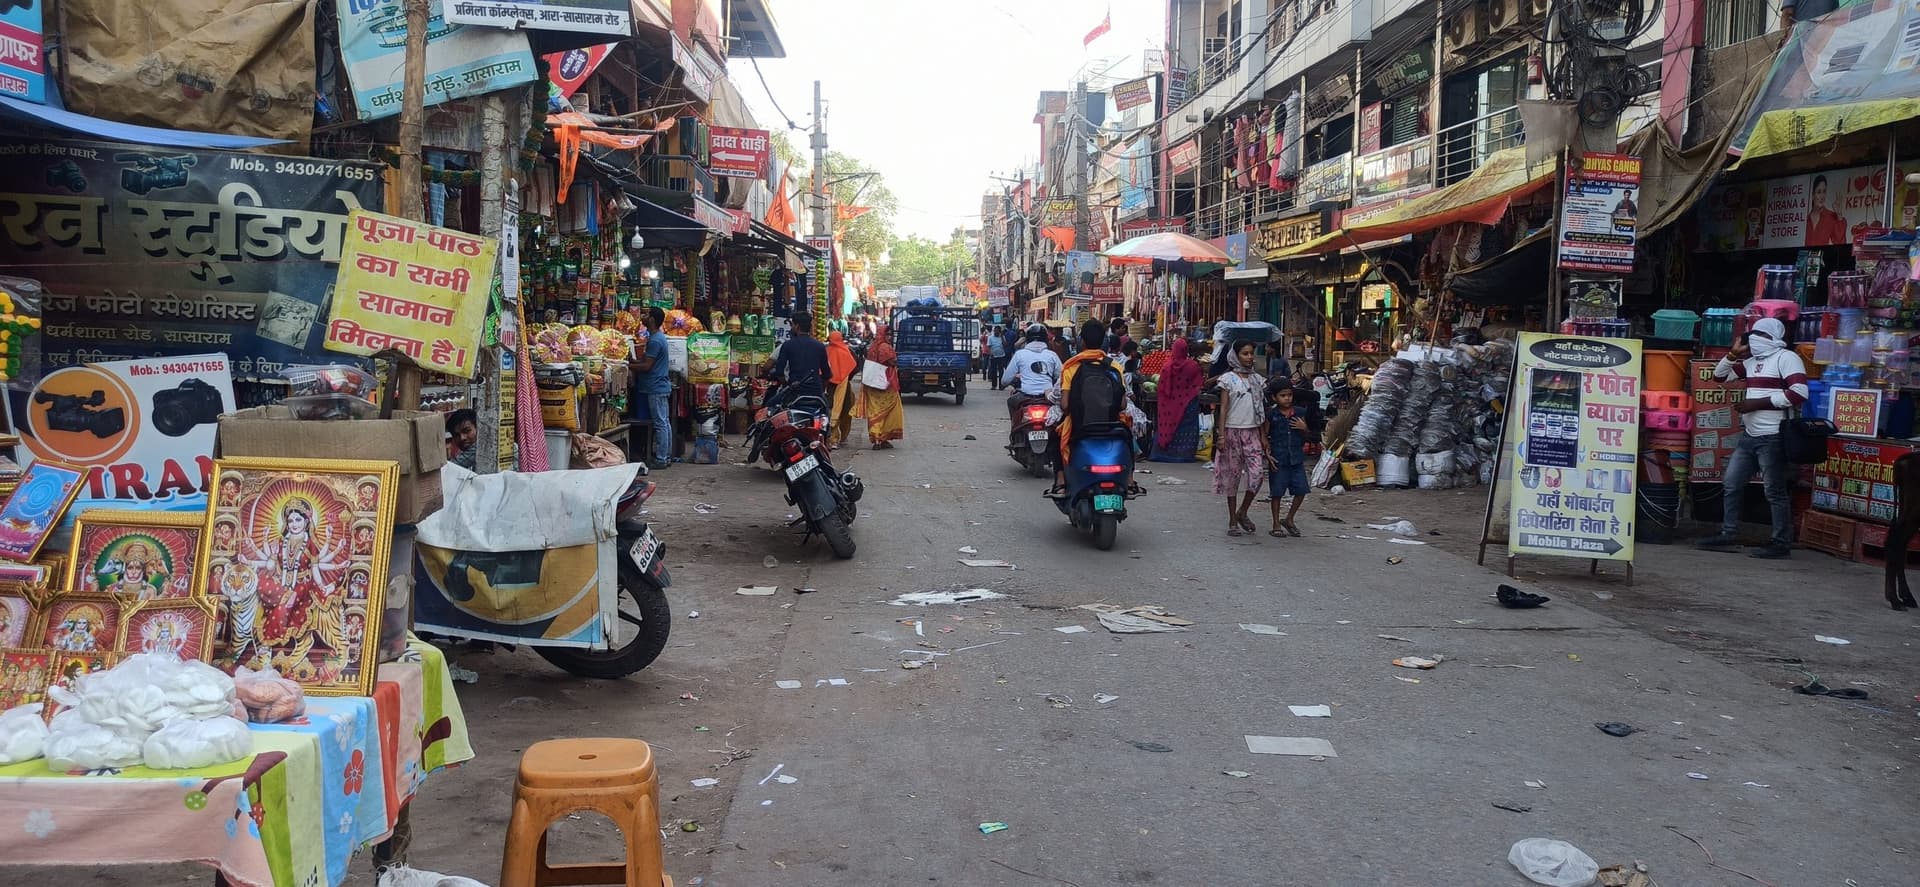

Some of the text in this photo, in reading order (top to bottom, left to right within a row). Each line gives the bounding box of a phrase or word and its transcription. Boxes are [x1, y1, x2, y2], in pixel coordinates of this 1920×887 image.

[454, 4, 487, 17] प्रमिला
[540, 11, 602, 25] आरा-सासाराम
[605, 13, 619, 26] रोड
[462, 58, 522, 84] सासाराम
[230, 157, 374, 182] Mob. 9430471655
[1613, 160, 1640, 174] GANGA
[1773, 184, 1804, 197] PRINCE
[1767, 198, 1806, 211] KIRANA &
[1766, 211, 1806, 225] GENERAL
[356, 215, 484, 257] पूजा-पाठ
[1770, 226, 1799, 238] STORE
[356, 253, 400, 278] का
[407, 263, 471, 293] सभी
[85, 290, 144, 315] फोटो
[150, 293, 257, 321] स्पेशलिस्ट
[358, 290, 456, 327] सामान
[46, 323, 117, 341] धर्मशाला
[163, 329, 233, 346] सासाराम
[329, 319, 425, 358] मिलता
[130, 361, 224, 377] Mob.: 9430471655
[911, 357, 954, 367] BAXY
[1597, 368, 1637, 397] फोन
[1695, 385, 1728, 404] बदले
[1585, 402, 1637, 424] ब्याज
[1596, 427, 1625, 447] पर
[1536, 489, 1614, 513] यहाँ मोबाईल
[1517, 508, 1575, 532] रिपेयरिंग
[1579, 515, 1606, 534] होता
[1527, 534, 1604, 551] Mobile Plaza
